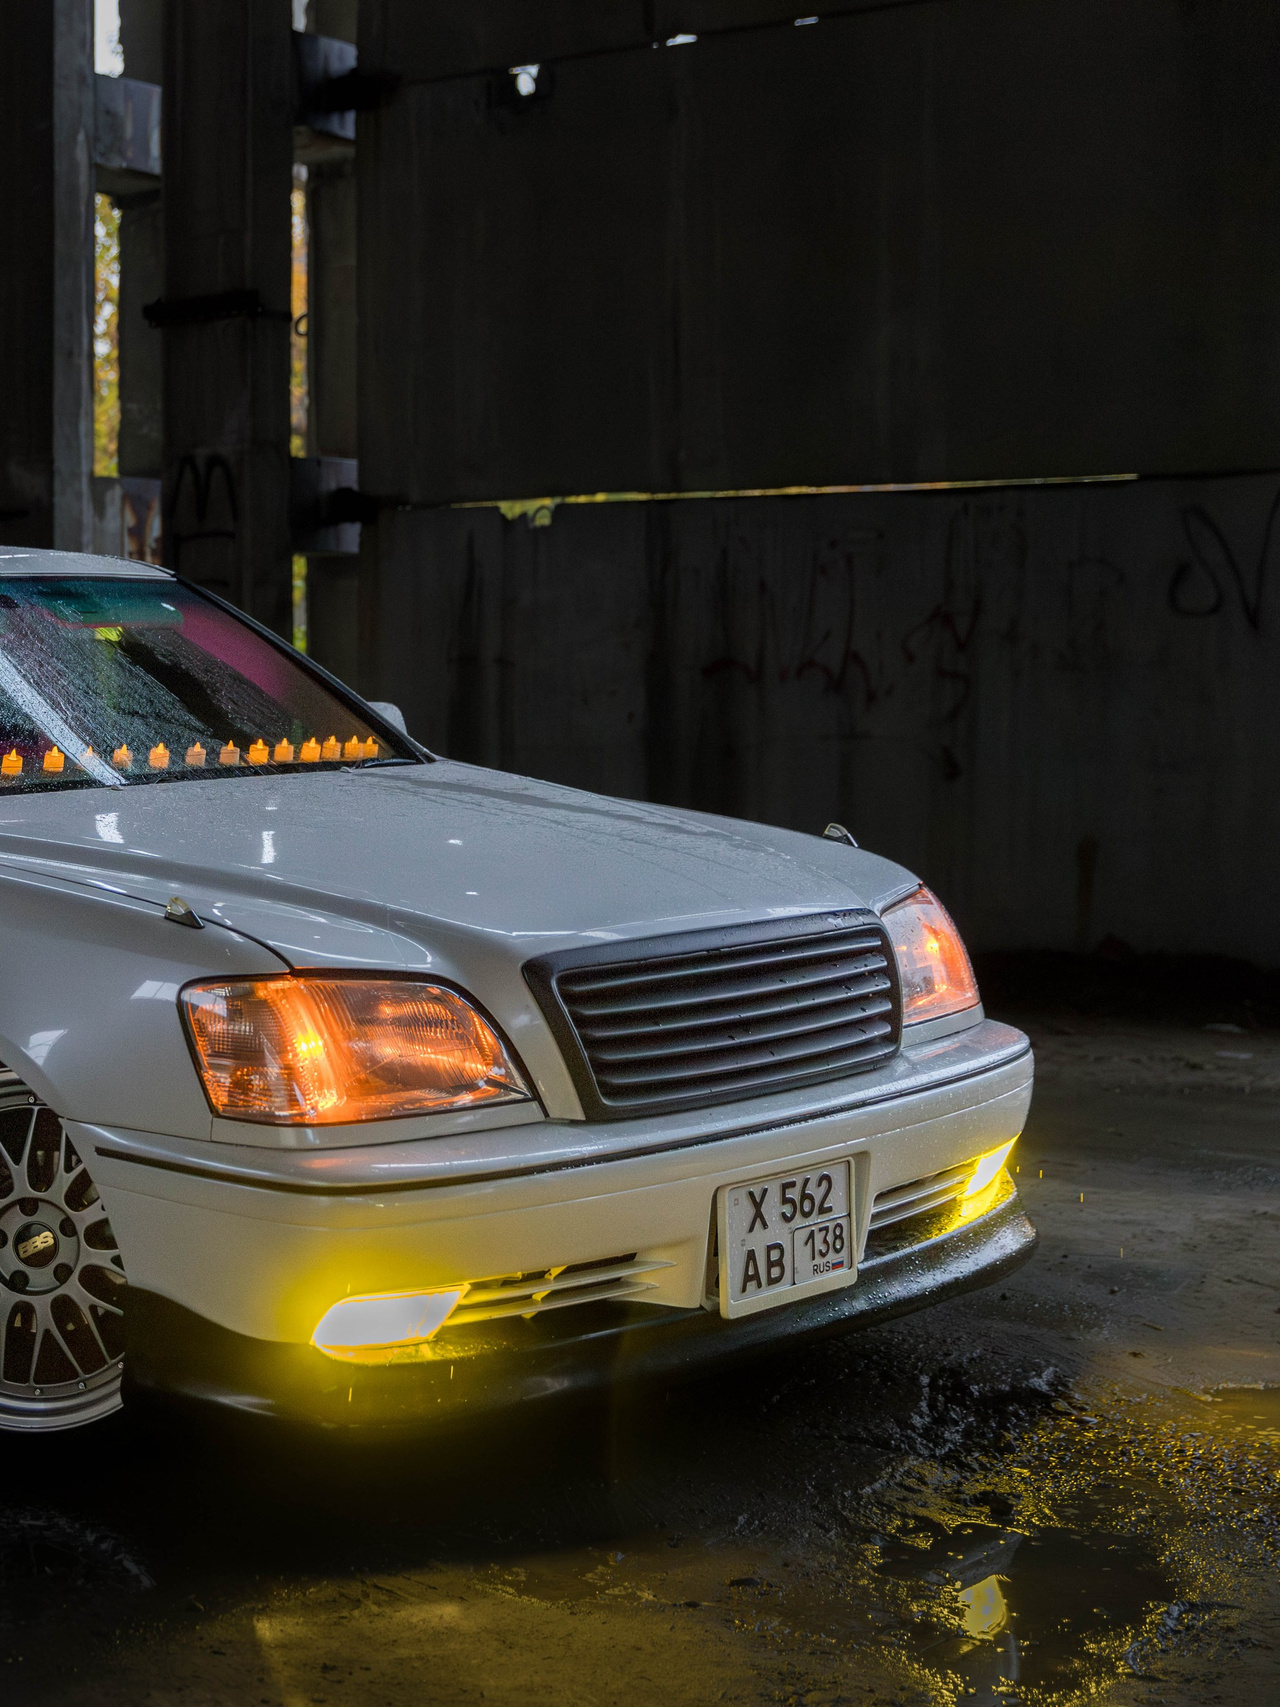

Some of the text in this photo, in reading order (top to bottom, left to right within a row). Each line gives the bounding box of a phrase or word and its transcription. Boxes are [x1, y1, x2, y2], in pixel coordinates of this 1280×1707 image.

[748, 1171, 833, 1233] X 562
[741, 1222, 845, 1293] AB 138
[812, 1261, 831, 1276] RUS
